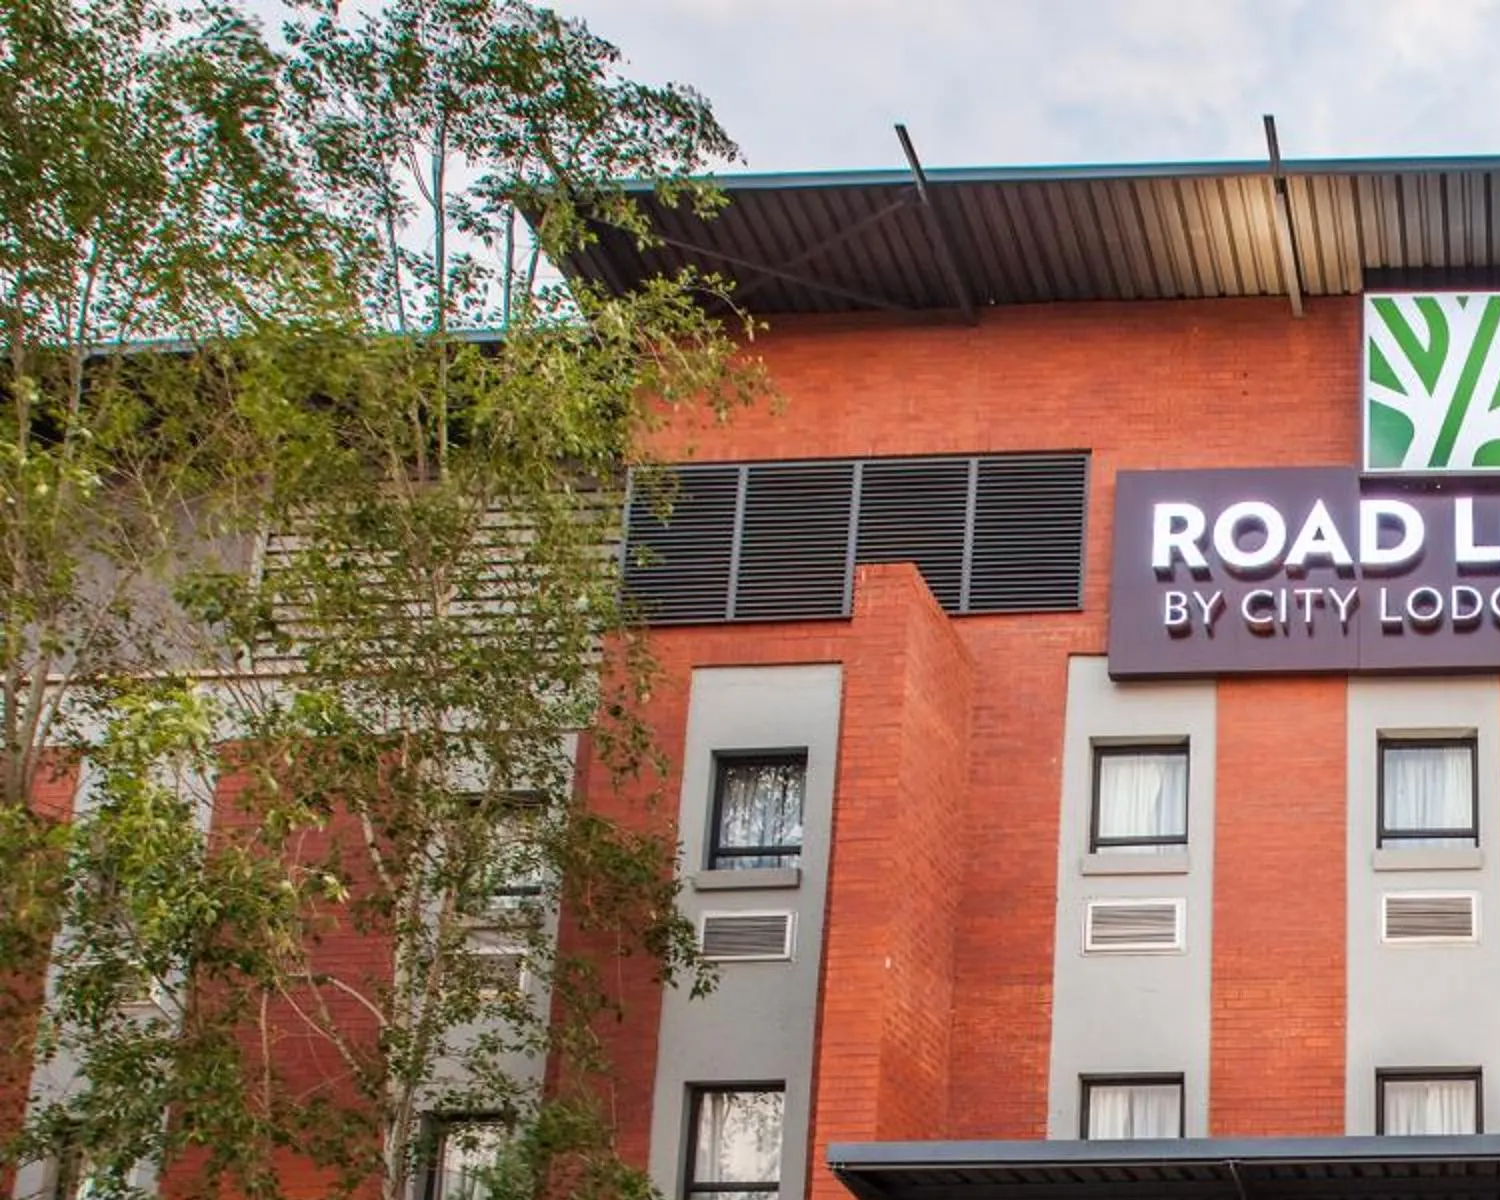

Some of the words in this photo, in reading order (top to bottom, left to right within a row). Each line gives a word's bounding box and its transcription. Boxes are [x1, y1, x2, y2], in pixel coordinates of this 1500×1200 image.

[1151, 498, 1426, 570] ROAD
[1163, 590, 1222, 626] BY
[1241, 586, 1359, 624] CITY
